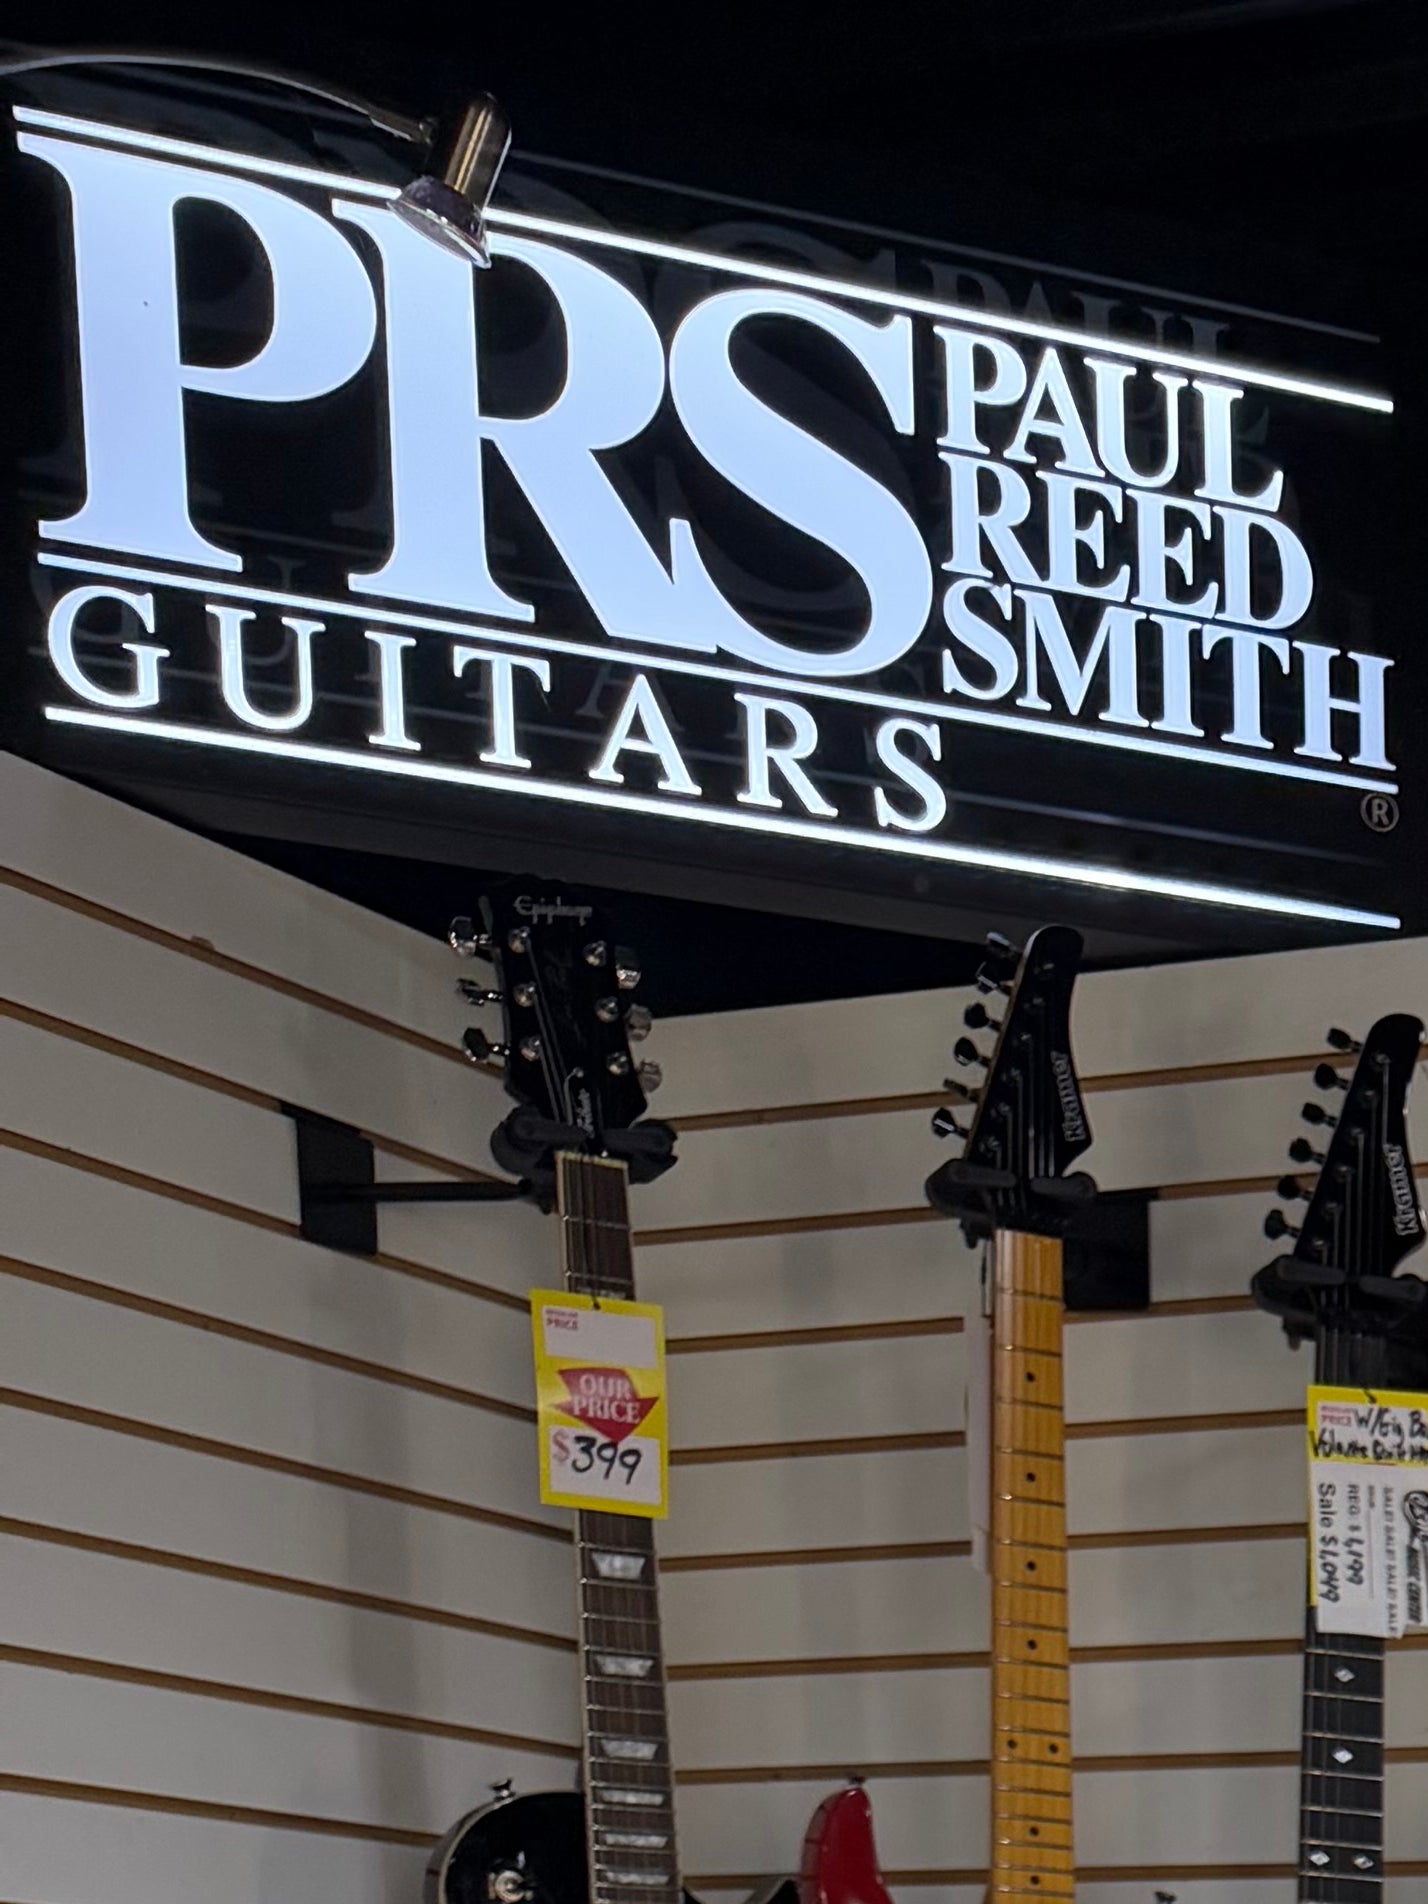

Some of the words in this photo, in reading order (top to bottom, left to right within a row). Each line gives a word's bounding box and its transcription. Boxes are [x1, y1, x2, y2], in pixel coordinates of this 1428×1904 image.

[16, 131, 933, 680] PRS
[931, 326, 1283, 512] PAUL
[940, 453, 1315, 631] REED
[47, 585, 945, 832] GUITARS
[942, 580, 1396, 771] SMITH
[552, 1429, 642, 1486] $399
[572, 1395, 641, 1425] PRICE
[579, 1374, 632, 1400] OUR
[1318, 1482, 1337, 1528] Sale
